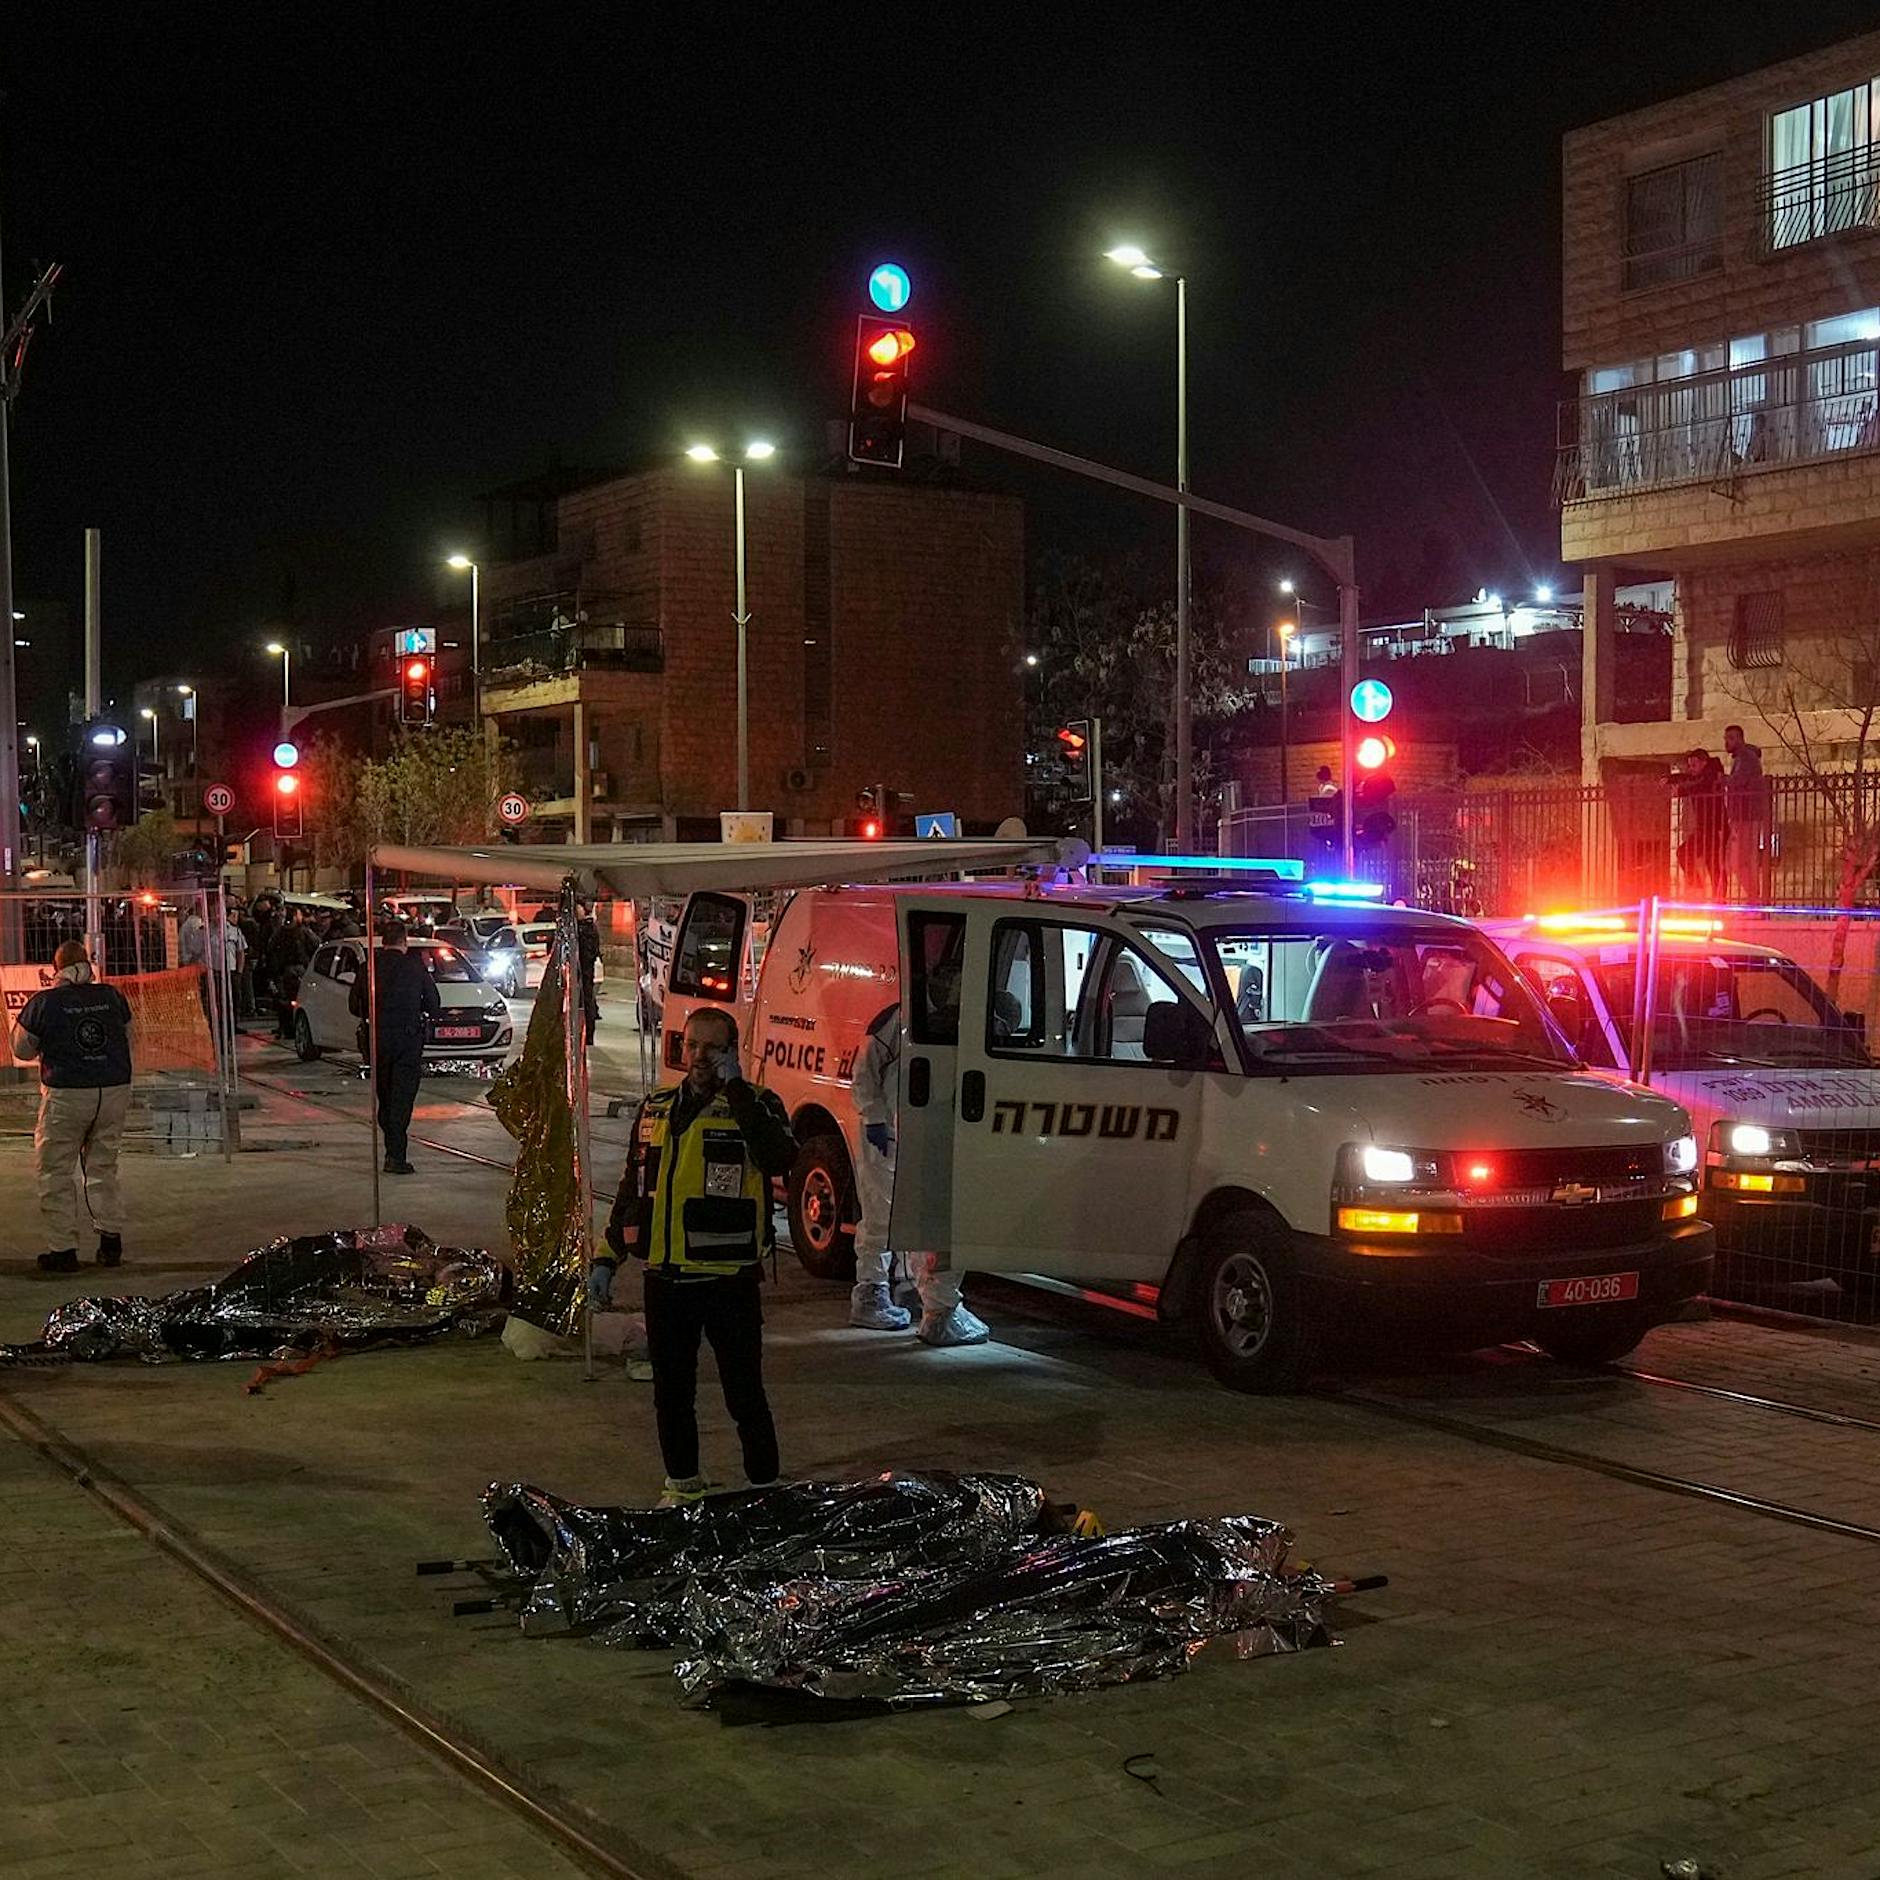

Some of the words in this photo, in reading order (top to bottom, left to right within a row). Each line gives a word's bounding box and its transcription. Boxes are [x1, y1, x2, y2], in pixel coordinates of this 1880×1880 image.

[211, 793, 228, 806] 30
[505, 802, 521, 815] 30
[764, 1039, 826, 1073] POLICE
[992, 1101, 1180, 1141] משטרה
[1564, 1276, 1621, 1301] 40-036
